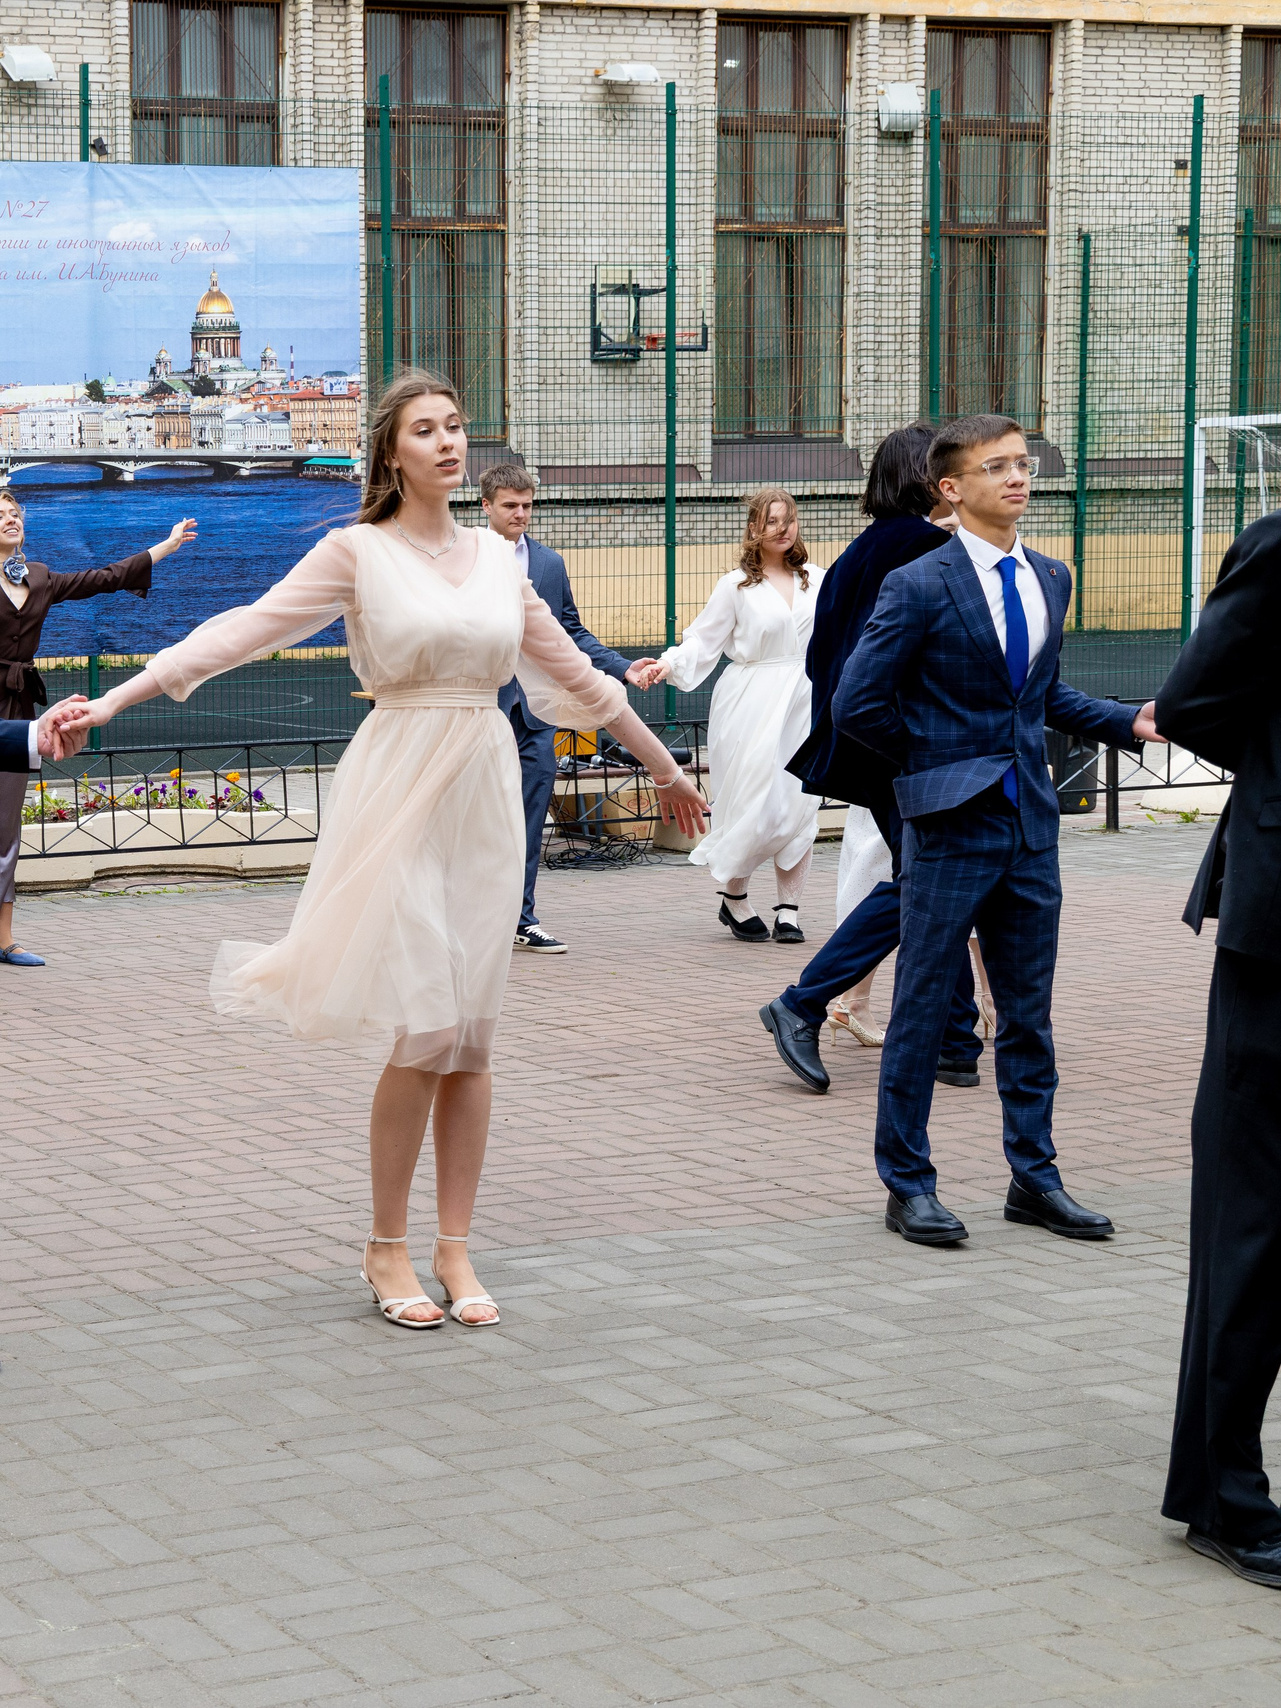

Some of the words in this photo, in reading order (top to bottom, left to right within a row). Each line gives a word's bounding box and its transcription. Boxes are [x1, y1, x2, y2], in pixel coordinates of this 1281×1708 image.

[0, 199, 51, 219] №27
[36, 238, 52, 250] и
[55, 238, 169, 266] иностранных
[170, 229, 232, 265] языков
[15, 270, 48, 281] им.
